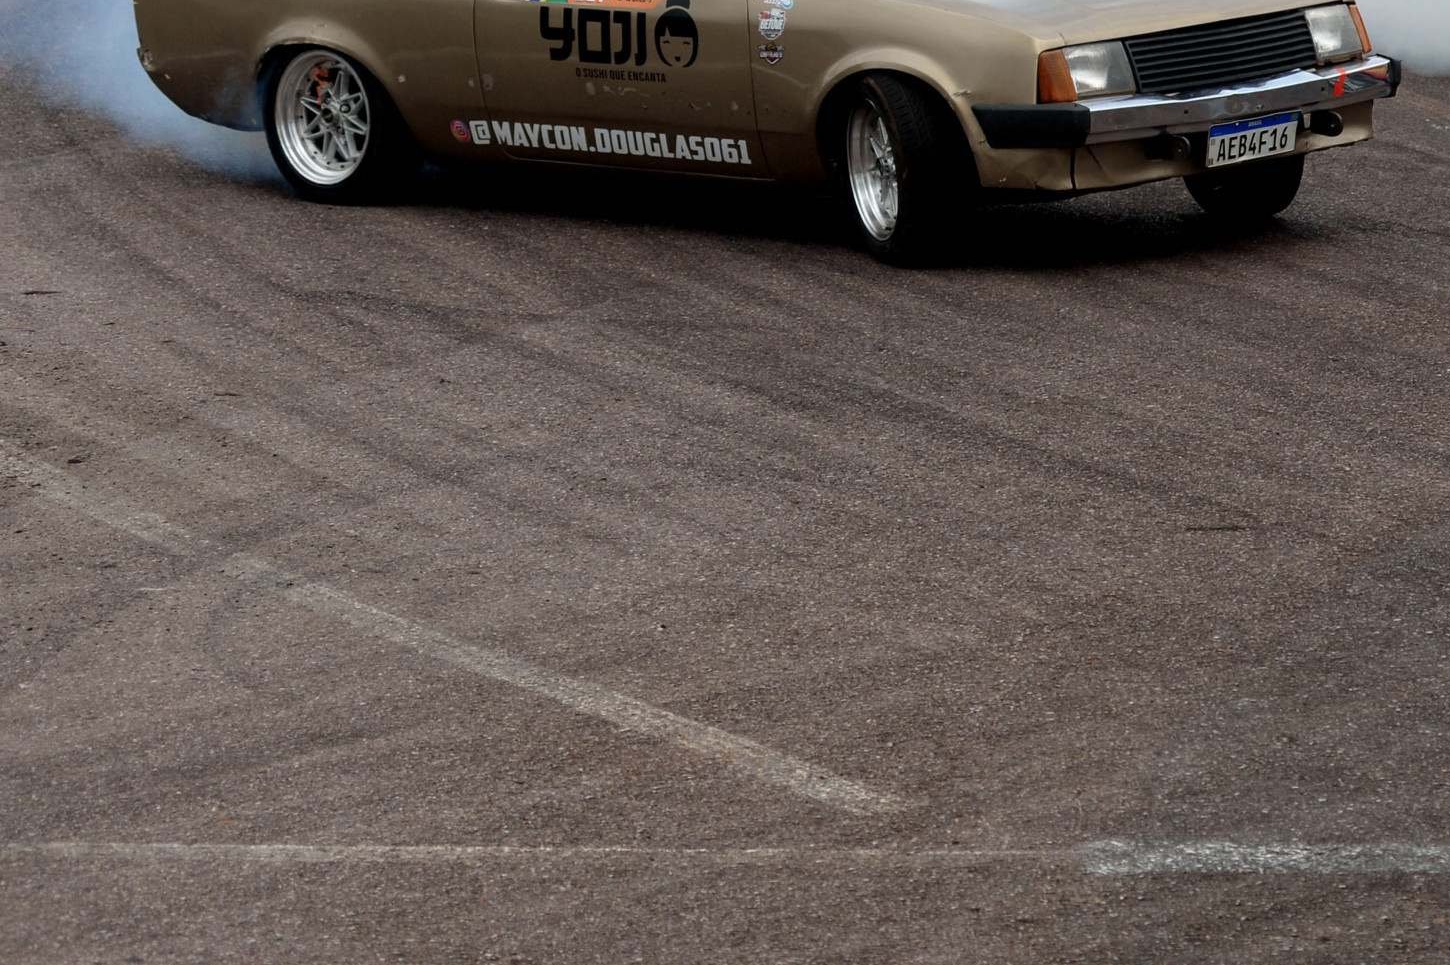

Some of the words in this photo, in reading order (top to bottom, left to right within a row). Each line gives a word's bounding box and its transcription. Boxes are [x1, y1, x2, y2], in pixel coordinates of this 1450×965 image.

[575, 67, 583, 78] O
[583, 68, 608, 80] SUSHI
[609, 70, 626, 82] QUE
[627, 71, 667, 84] ENCANTA
[468, 119, 752, 165] @MAYCON.DOUGLAS061
[1216, 126, 1289, 163] AEB4F16
